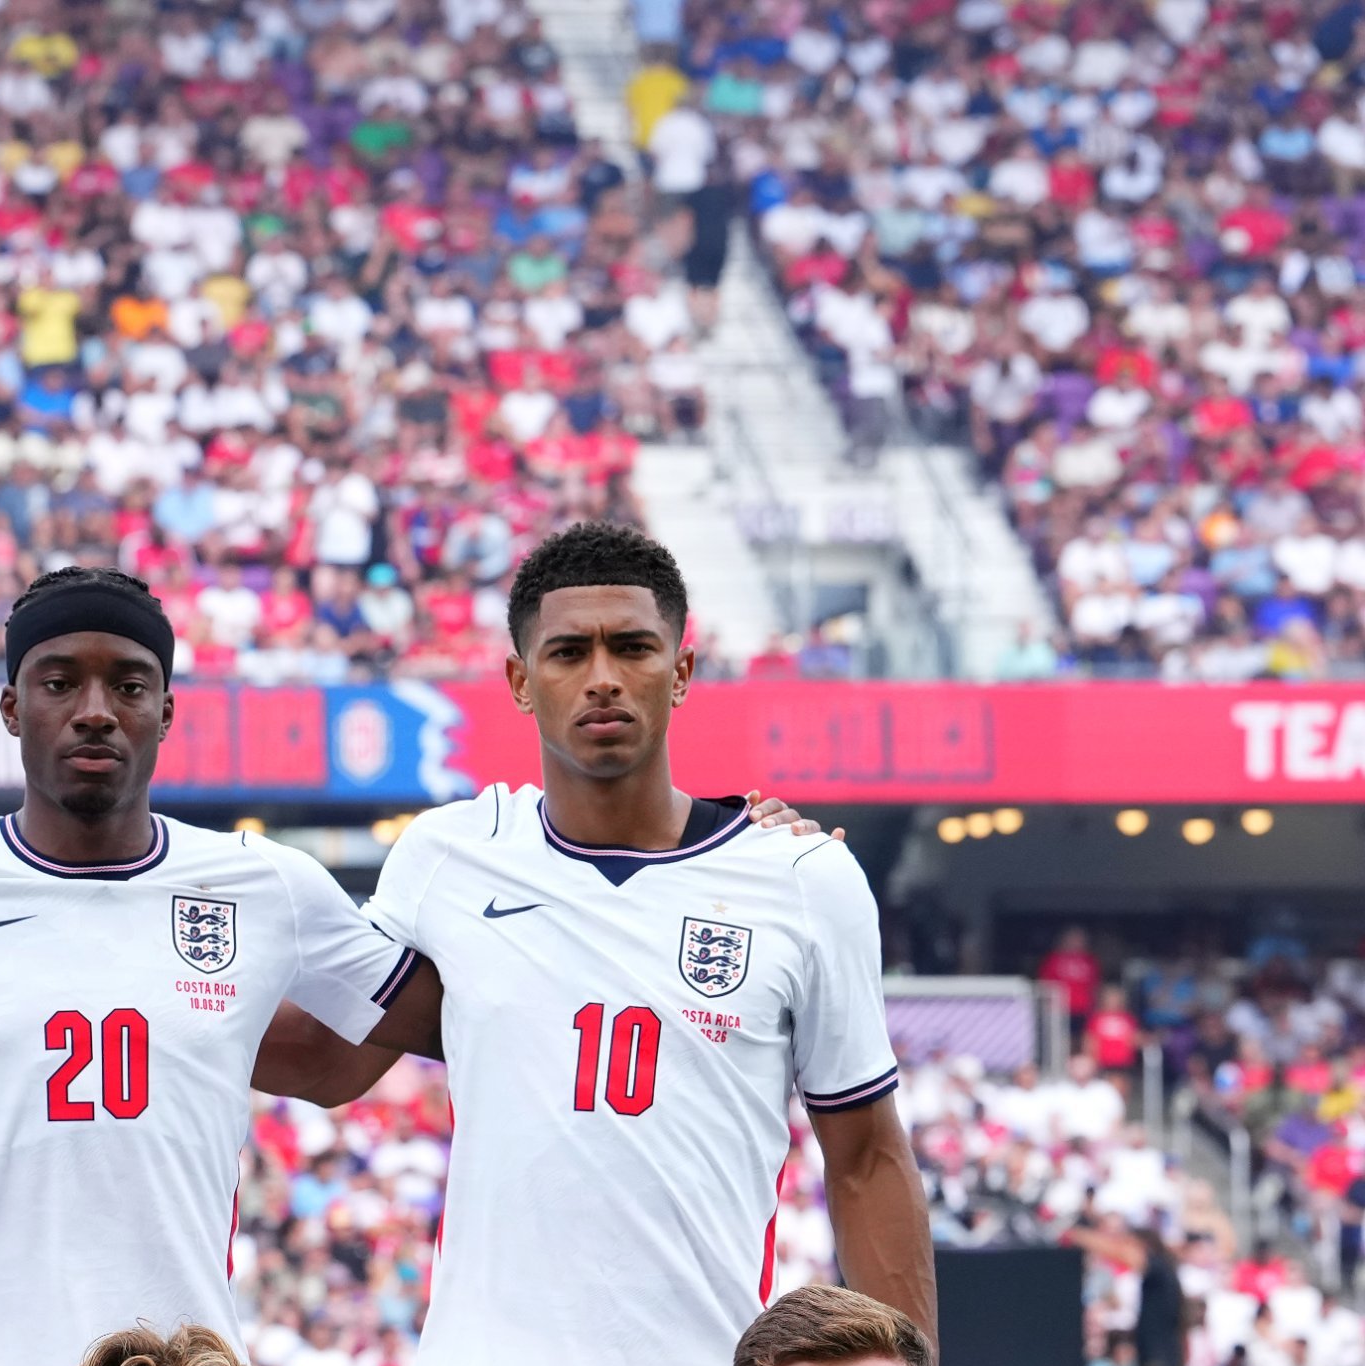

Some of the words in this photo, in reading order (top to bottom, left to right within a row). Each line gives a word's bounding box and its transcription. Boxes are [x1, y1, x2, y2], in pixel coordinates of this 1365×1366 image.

[175, 980, 212, 995] COSTA
[214, 982, 236, 998] RICA
[190, 997, 226, 1013] 10.06.26
[714, 1013, 742, 1029] RICA
[44, 1007, 149, 1121] 20
[573, 1002, 662, 1117] 10
